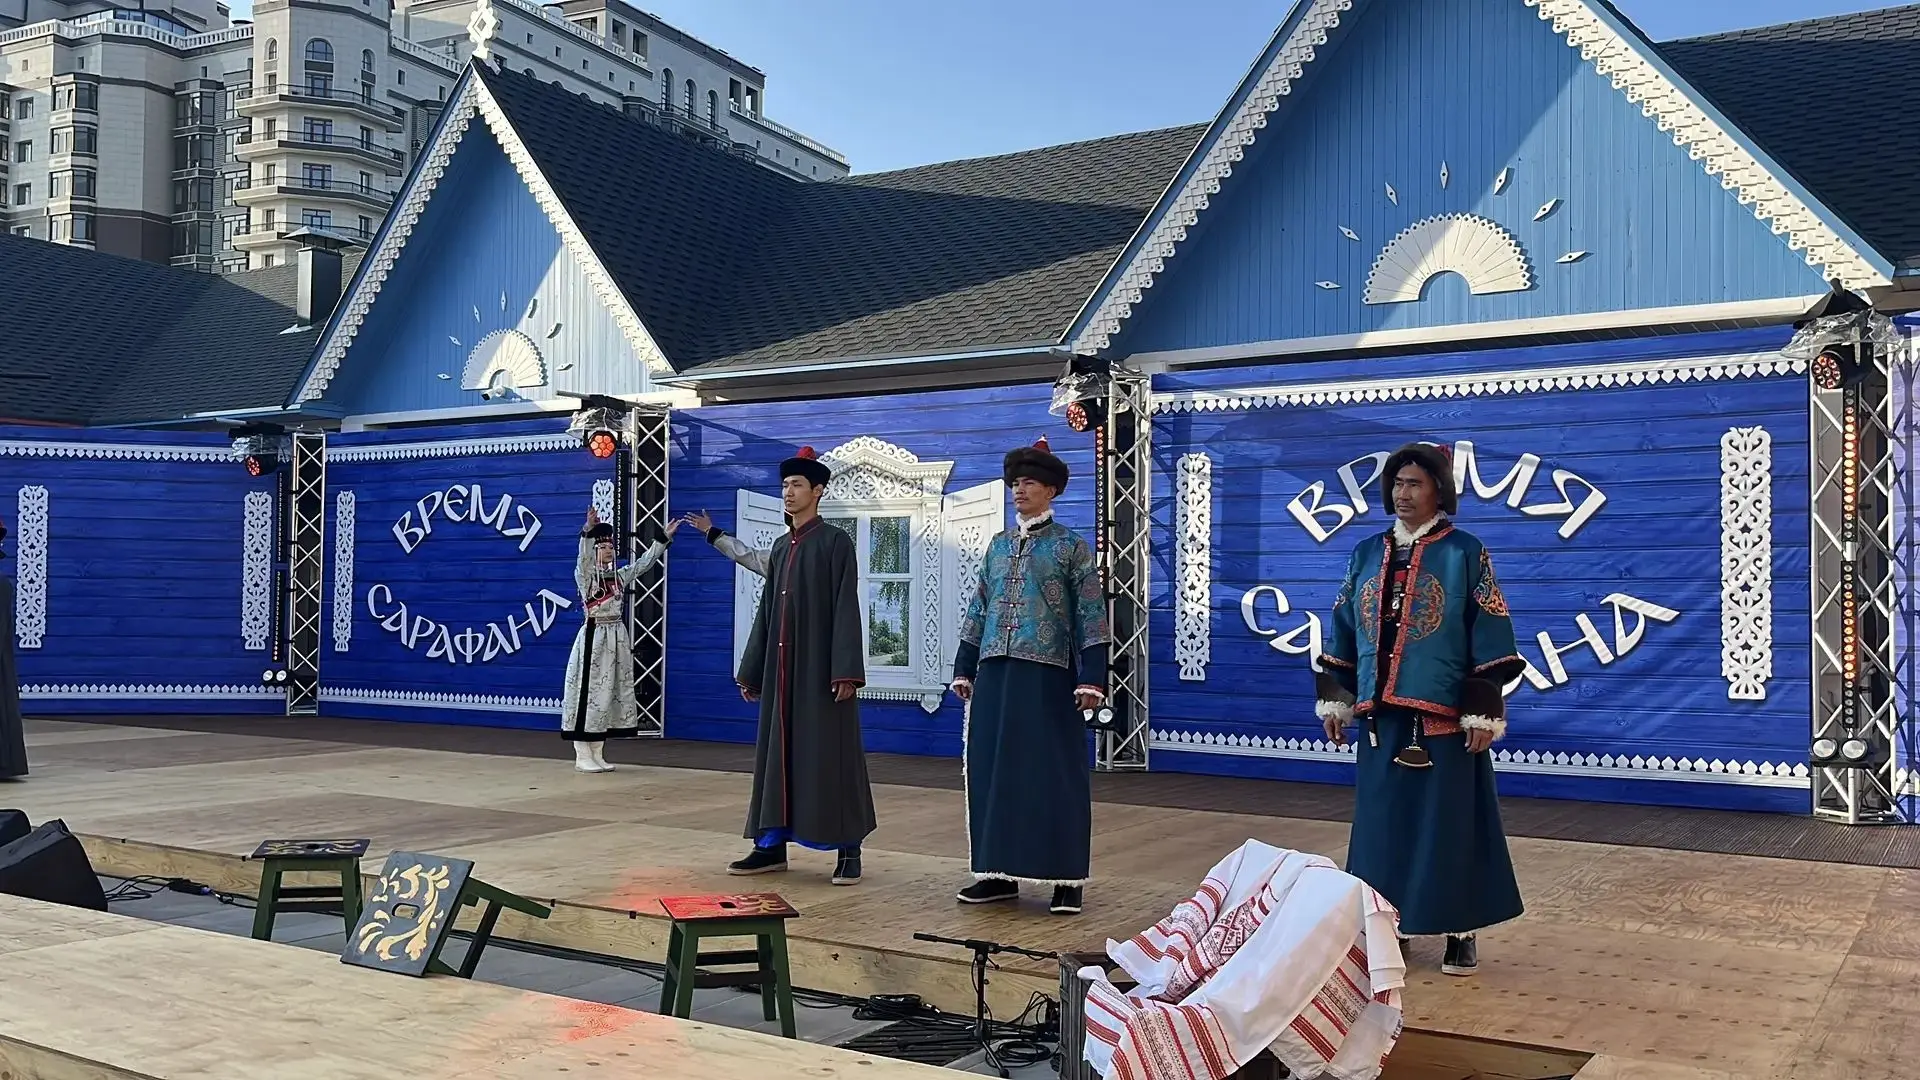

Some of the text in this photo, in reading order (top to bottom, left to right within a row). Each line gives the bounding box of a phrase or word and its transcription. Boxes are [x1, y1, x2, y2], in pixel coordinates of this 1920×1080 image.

[392, 484, 542, 554] ВРЕМЯ
[1286, 440, 1607, 543] ВРМЯ
[367, 584, 573, 664] САРАФАНА
